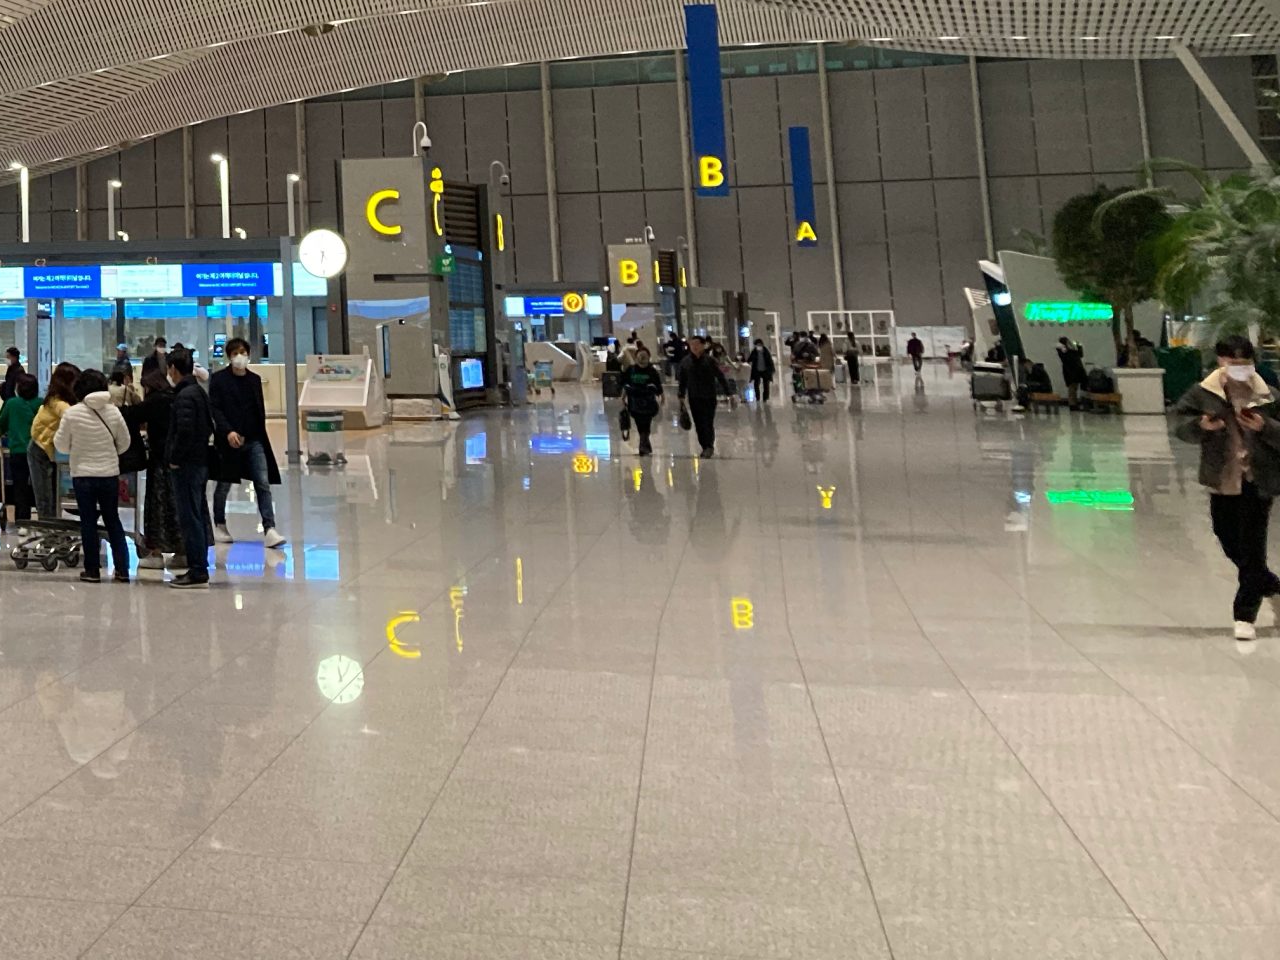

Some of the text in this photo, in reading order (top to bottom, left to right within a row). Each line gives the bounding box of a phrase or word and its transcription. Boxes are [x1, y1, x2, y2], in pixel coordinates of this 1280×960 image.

[699, 156, 724, 188] B
[365, 189, 402, 235] C
[795, 221, 818, 241] A
[619, 258, 640, 286] B
